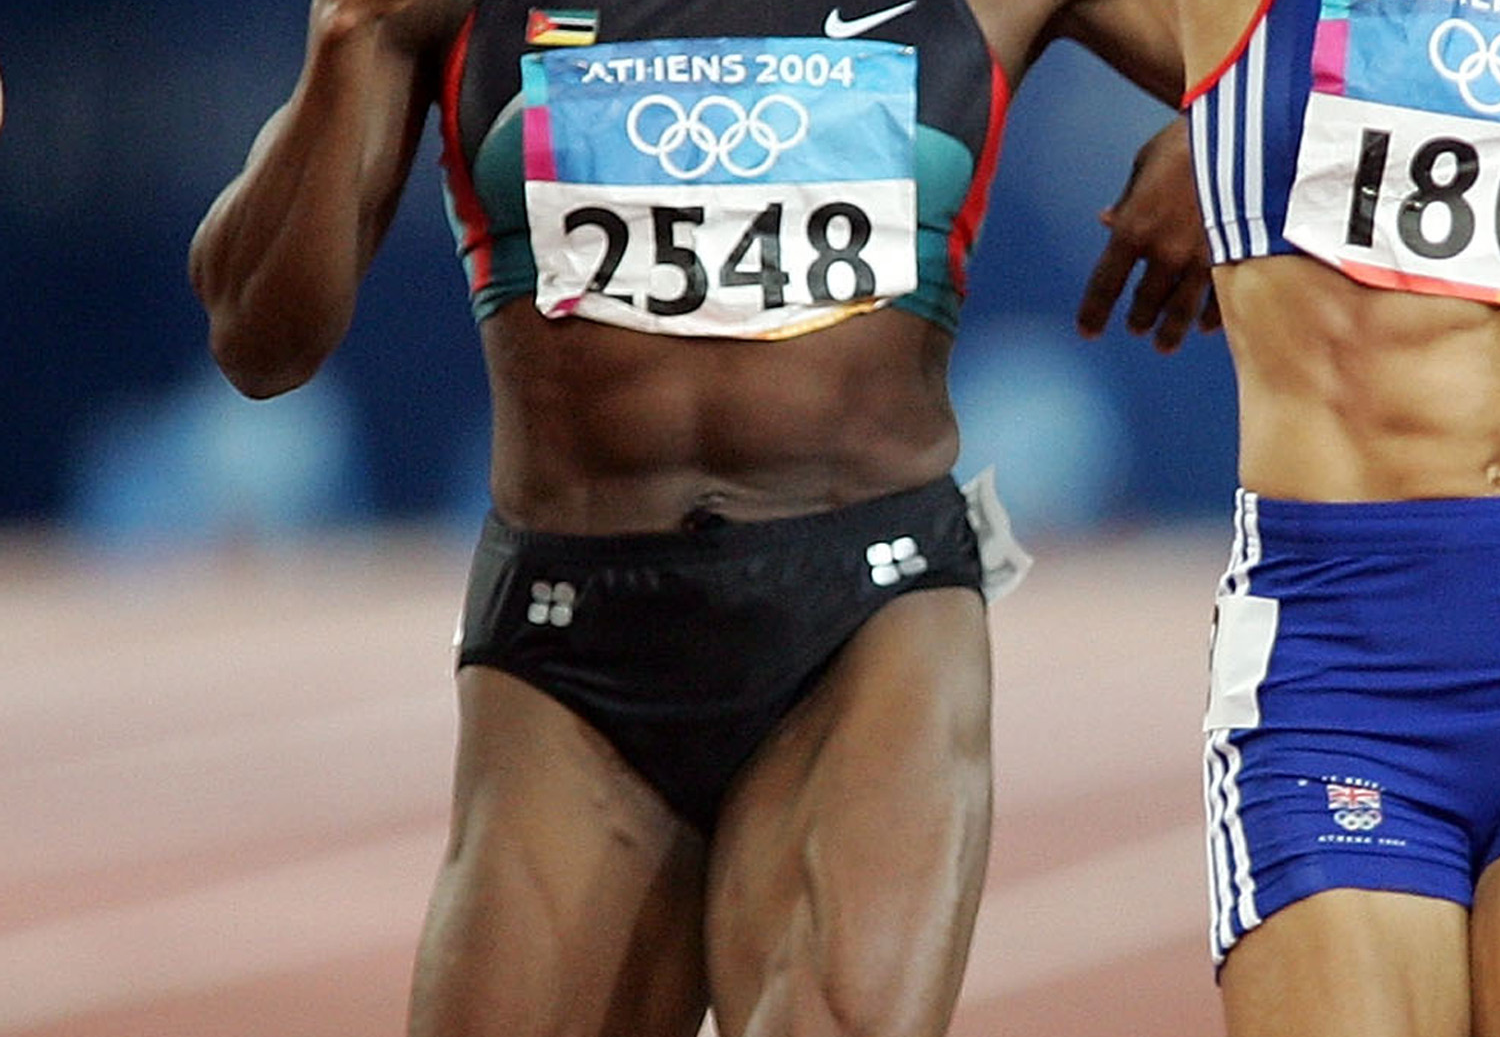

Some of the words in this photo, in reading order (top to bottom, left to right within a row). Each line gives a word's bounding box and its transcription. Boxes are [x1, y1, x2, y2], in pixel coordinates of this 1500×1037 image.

[580, 54, 747, 84] ATHENS
[755, 53, 854, 88] 2004
[564, 201, 877, 315] 2548
